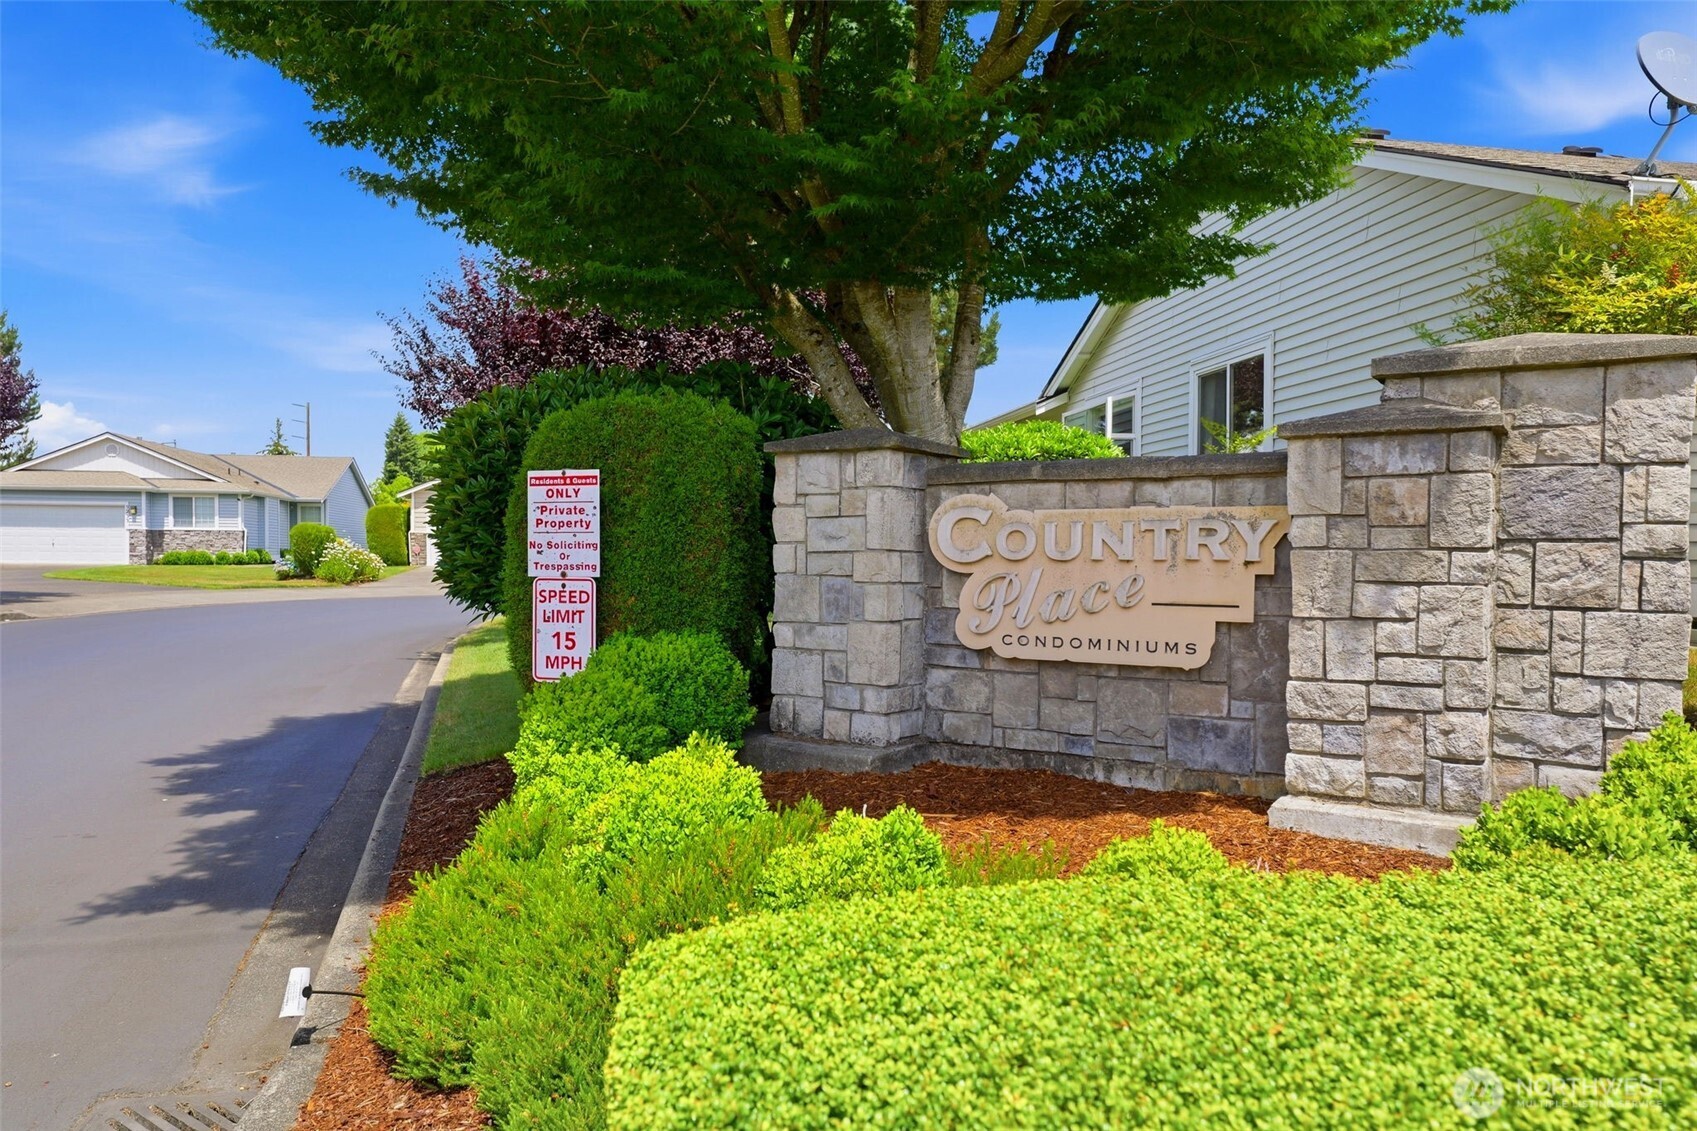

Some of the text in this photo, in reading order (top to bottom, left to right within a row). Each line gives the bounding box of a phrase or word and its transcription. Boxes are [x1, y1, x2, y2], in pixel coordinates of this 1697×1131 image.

[530, 477, 564, 485] Residents
[546, 488, 581, 499] ONLY
[540, 505, 586, 515] Private
[535, 518, 592, 530] Property
[936, 506, 1279, 564] COUNTRY
[529, 540, 598, 551] No Soliciting
[559, 553, 570, 561] Or
[533, 562, 597, 572] Trespassing
[538, 590, 590, 604] SPEED
[968, 567, 1146, 635] Place
[542, 610, 585, 624] LIMIT
[552, 632, 577, 651] 15
[1001, 633, 1198, 655] CONDOMINIUMS
[545, 655, 583, 670] MPH
